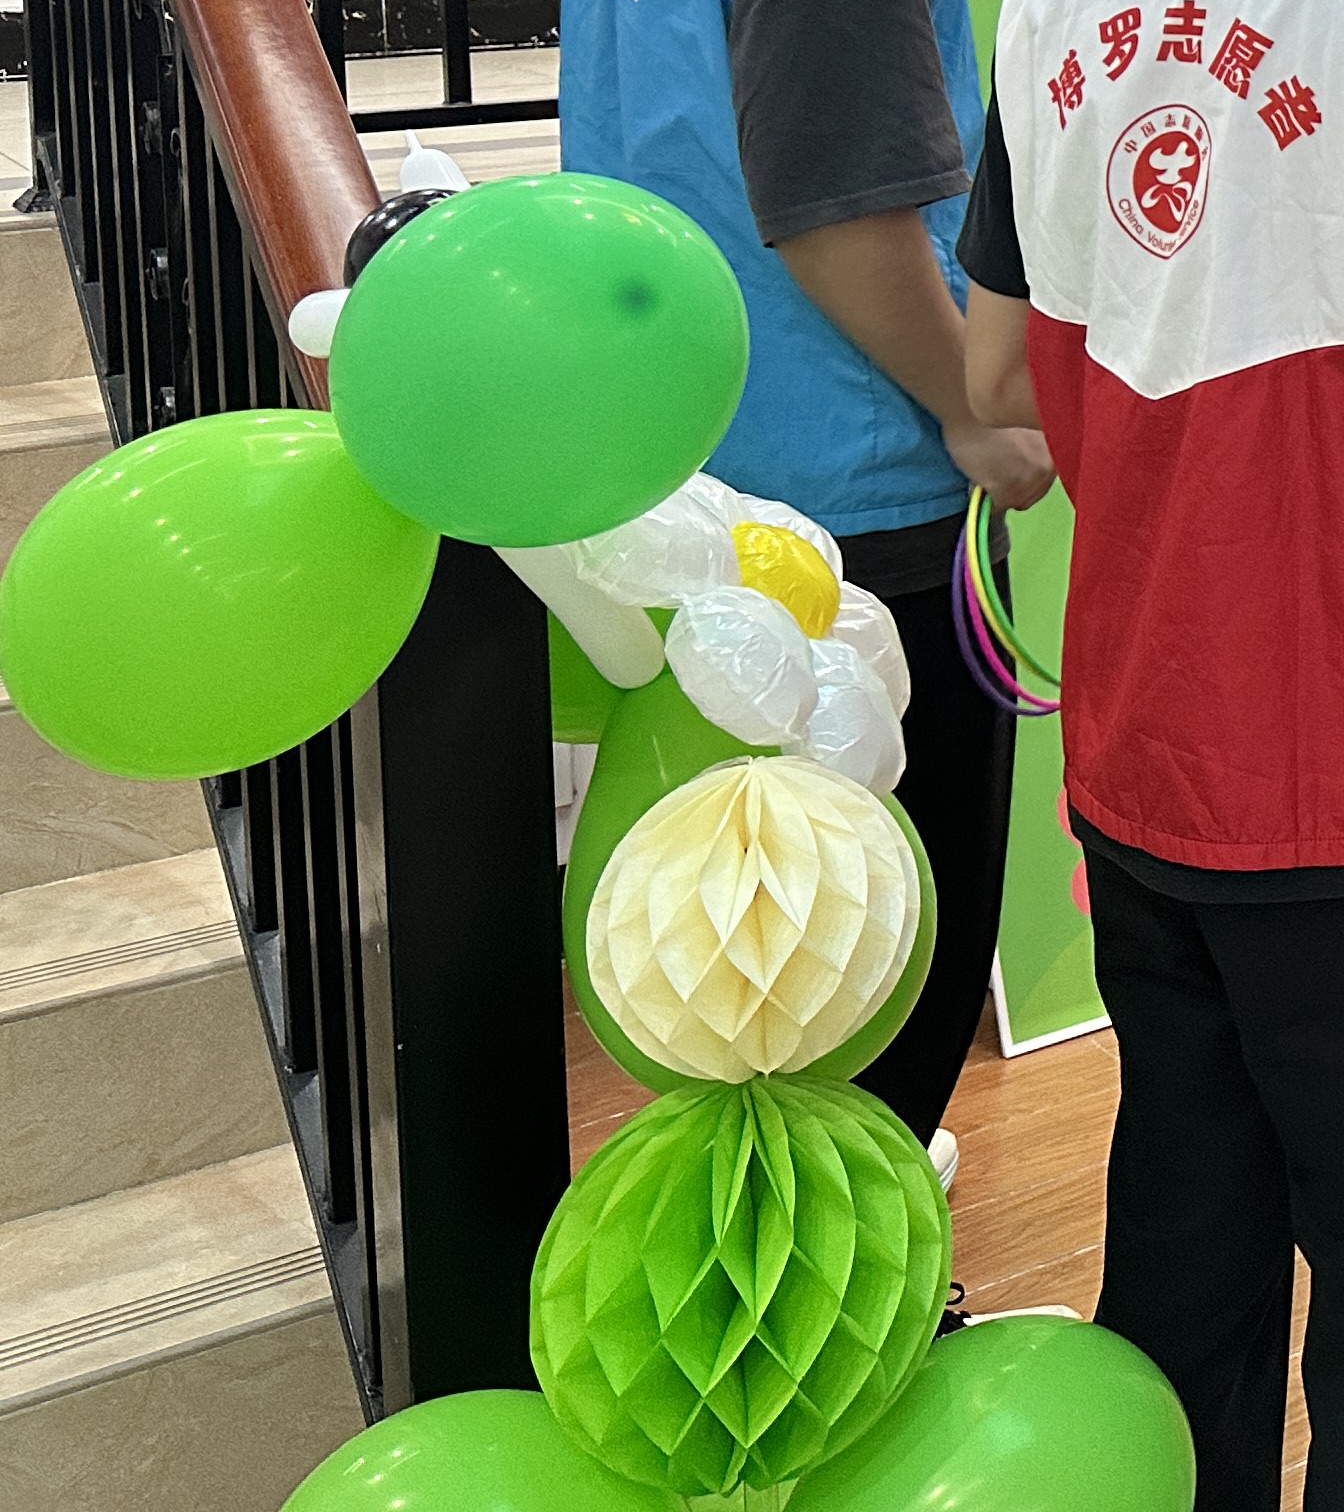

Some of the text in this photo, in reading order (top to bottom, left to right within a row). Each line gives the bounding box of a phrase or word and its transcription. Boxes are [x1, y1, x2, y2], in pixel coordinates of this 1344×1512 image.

[1048, 0, 1322, 151] 博罗志愿者
[1118, 198, 1145, 235] China
[1178, 199, 1200, 237] ervice
